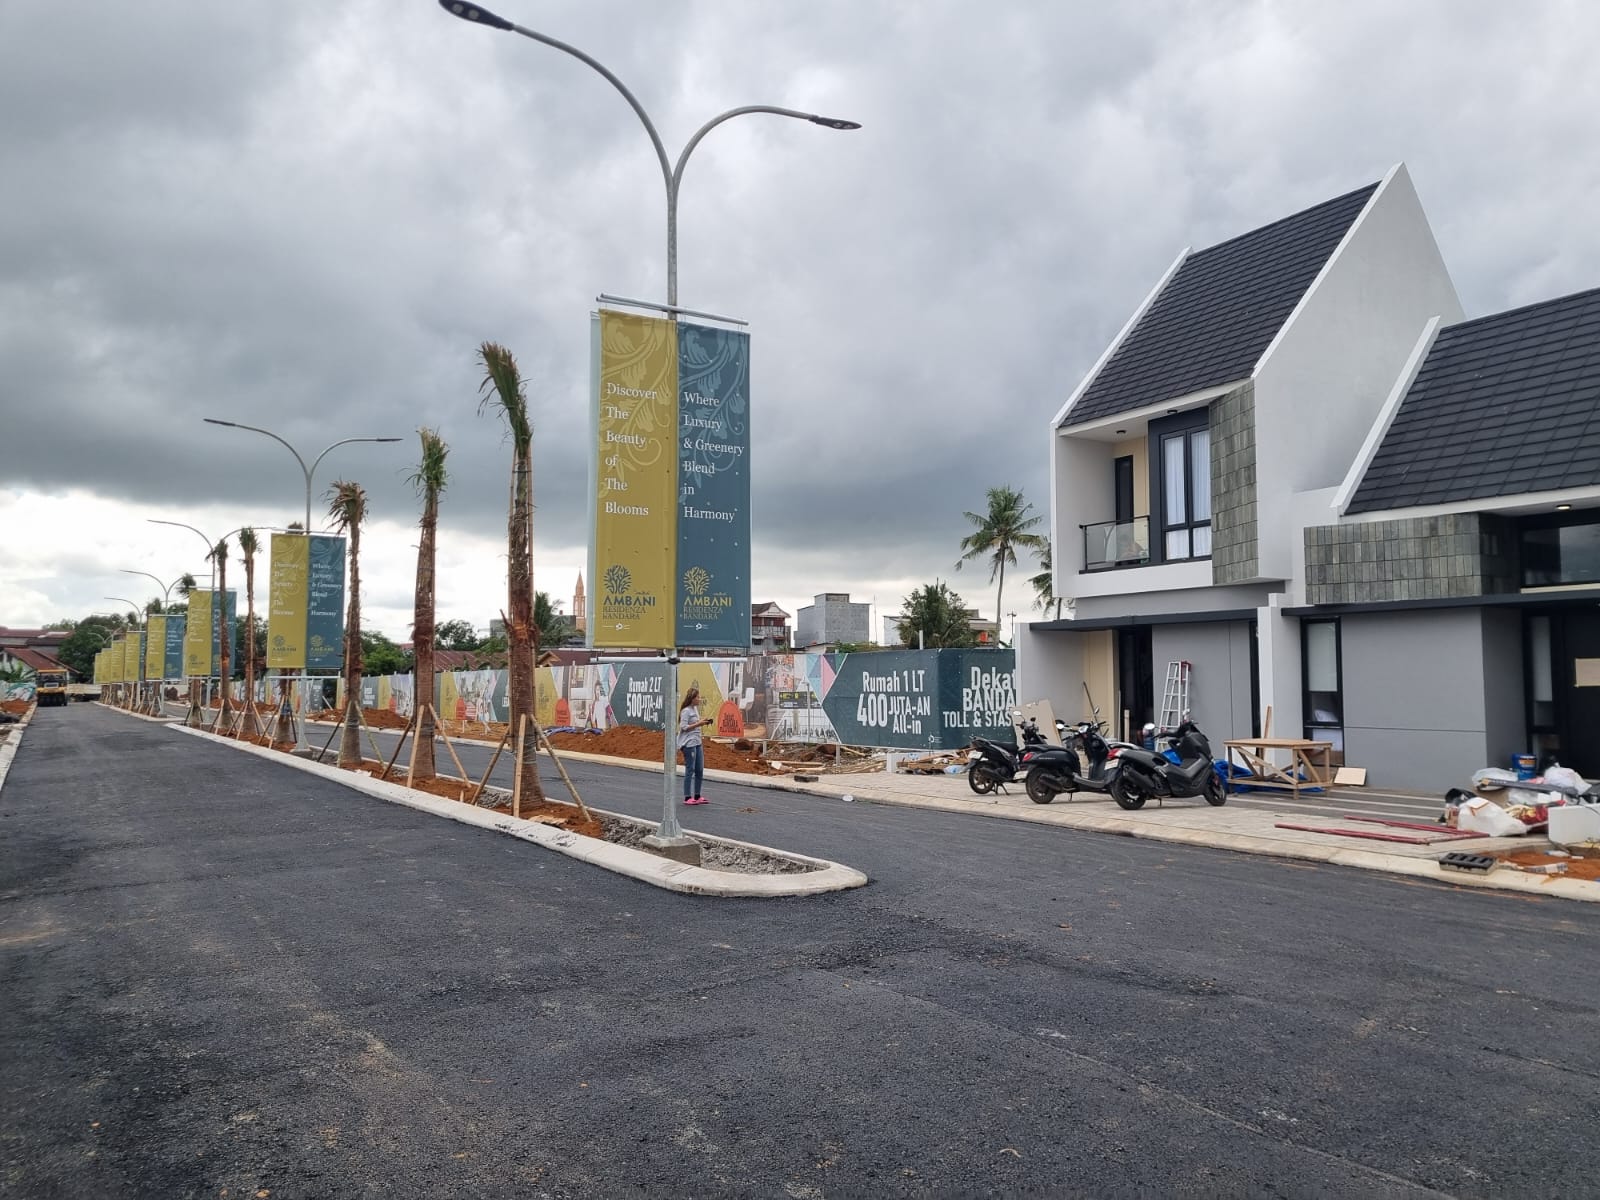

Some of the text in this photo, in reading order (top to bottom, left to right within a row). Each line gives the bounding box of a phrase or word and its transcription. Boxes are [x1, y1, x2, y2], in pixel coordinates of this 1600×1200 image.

[607, 382, 657, 400] Discover
[684, 392, 720, 406] Where
[607, 406, 630, 420] The
[684, 415, 722, 431] Luxury
[606, 430, 646, 447] Beauty
[683, 438, 744, 456] & Greenery
[605, 455, 619, 466] of
[684, 461, 715, 475] Blend
[605, 477, 628, 491] The
[683, 483, 695, 495] in
[605, 501, 649, 516] Blooms
[683, 506, 735, 523] Harmony
[603, 595, 656, 607] AMBANI
[684, 596, 732, 607] AMBANI
[628, 677, 648, 693] Rumah
[654, 676, 663, 693] LT
[863, 670, 925, 692] Rumah 1 LT
[626, 692, 642, 718] 500
[962, 688, 1016, 712] BANDA
[856, 693, 931, 728] 400 JUTA-AN
[892, 715, 922, 735] All-in
[943, 711, 970, 728] TOLL
[973, 711, 982, 728] &
